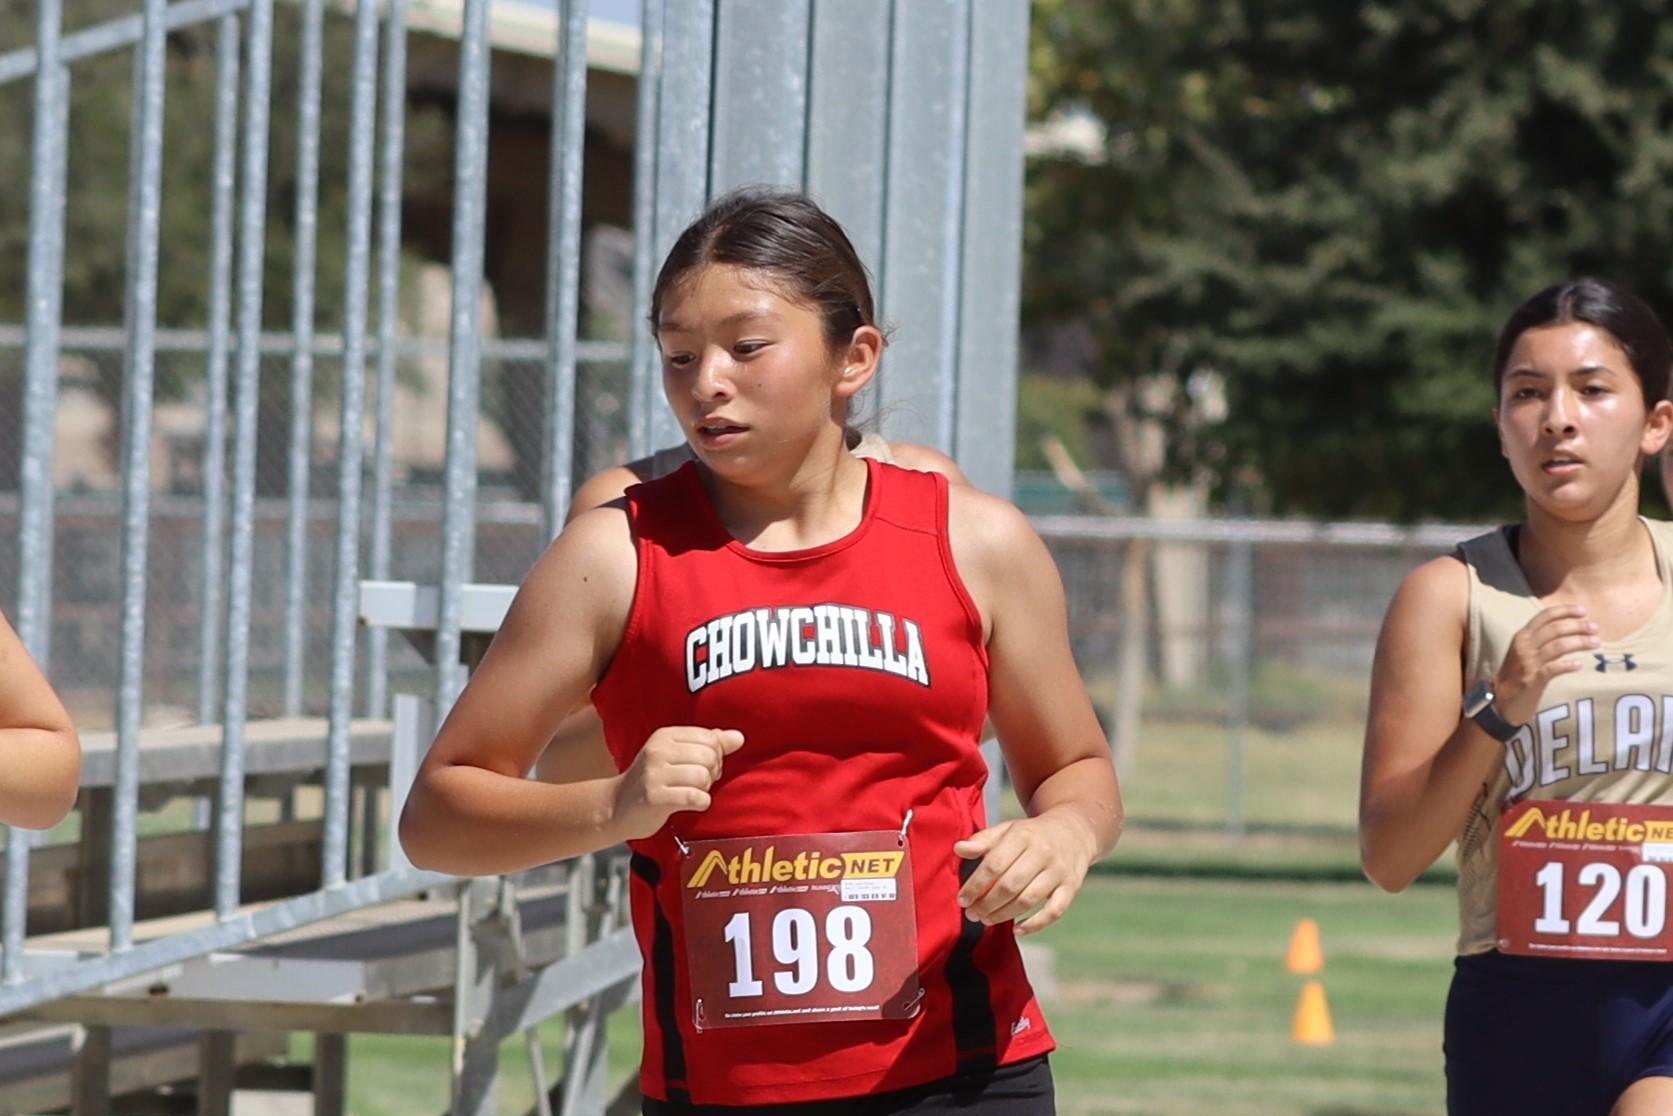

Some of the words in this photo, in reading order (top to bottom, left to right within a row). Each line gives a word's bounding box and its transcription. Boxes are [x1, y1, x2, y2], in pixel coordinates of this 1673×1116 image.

[684, 602, 931, 694] CHOWCHILLA
[1504, 806, 1645, 842] Athletic
[687, 845, 842, 888] Athletic
[850, 857, 896, 873] NET
[1534, 861, 1667, 938] 120
[723, 905, 875, 998] 198
